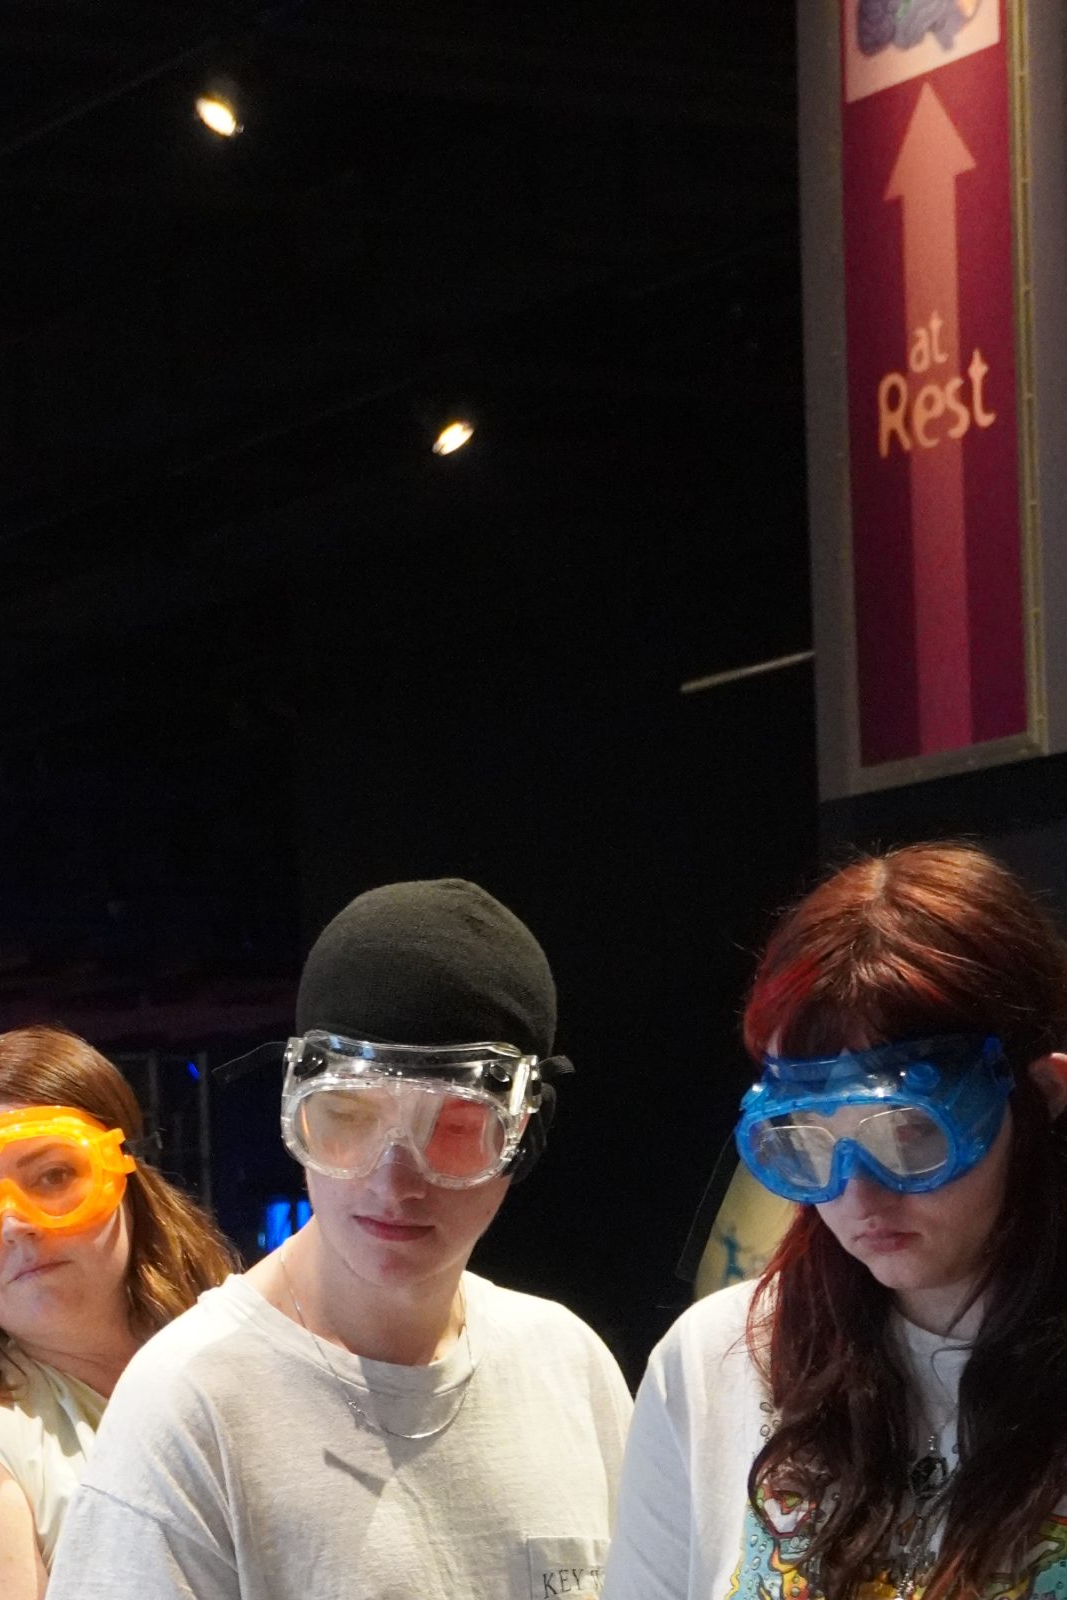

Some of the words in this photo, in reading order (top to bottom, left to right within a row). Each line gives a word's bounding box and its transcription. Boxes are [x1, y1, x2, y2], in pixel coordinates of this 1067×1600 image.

[909, 310, 949, 374] at
[877, 347, 998, 460] Rest
[542, 1568, 584, 1600] KEY
